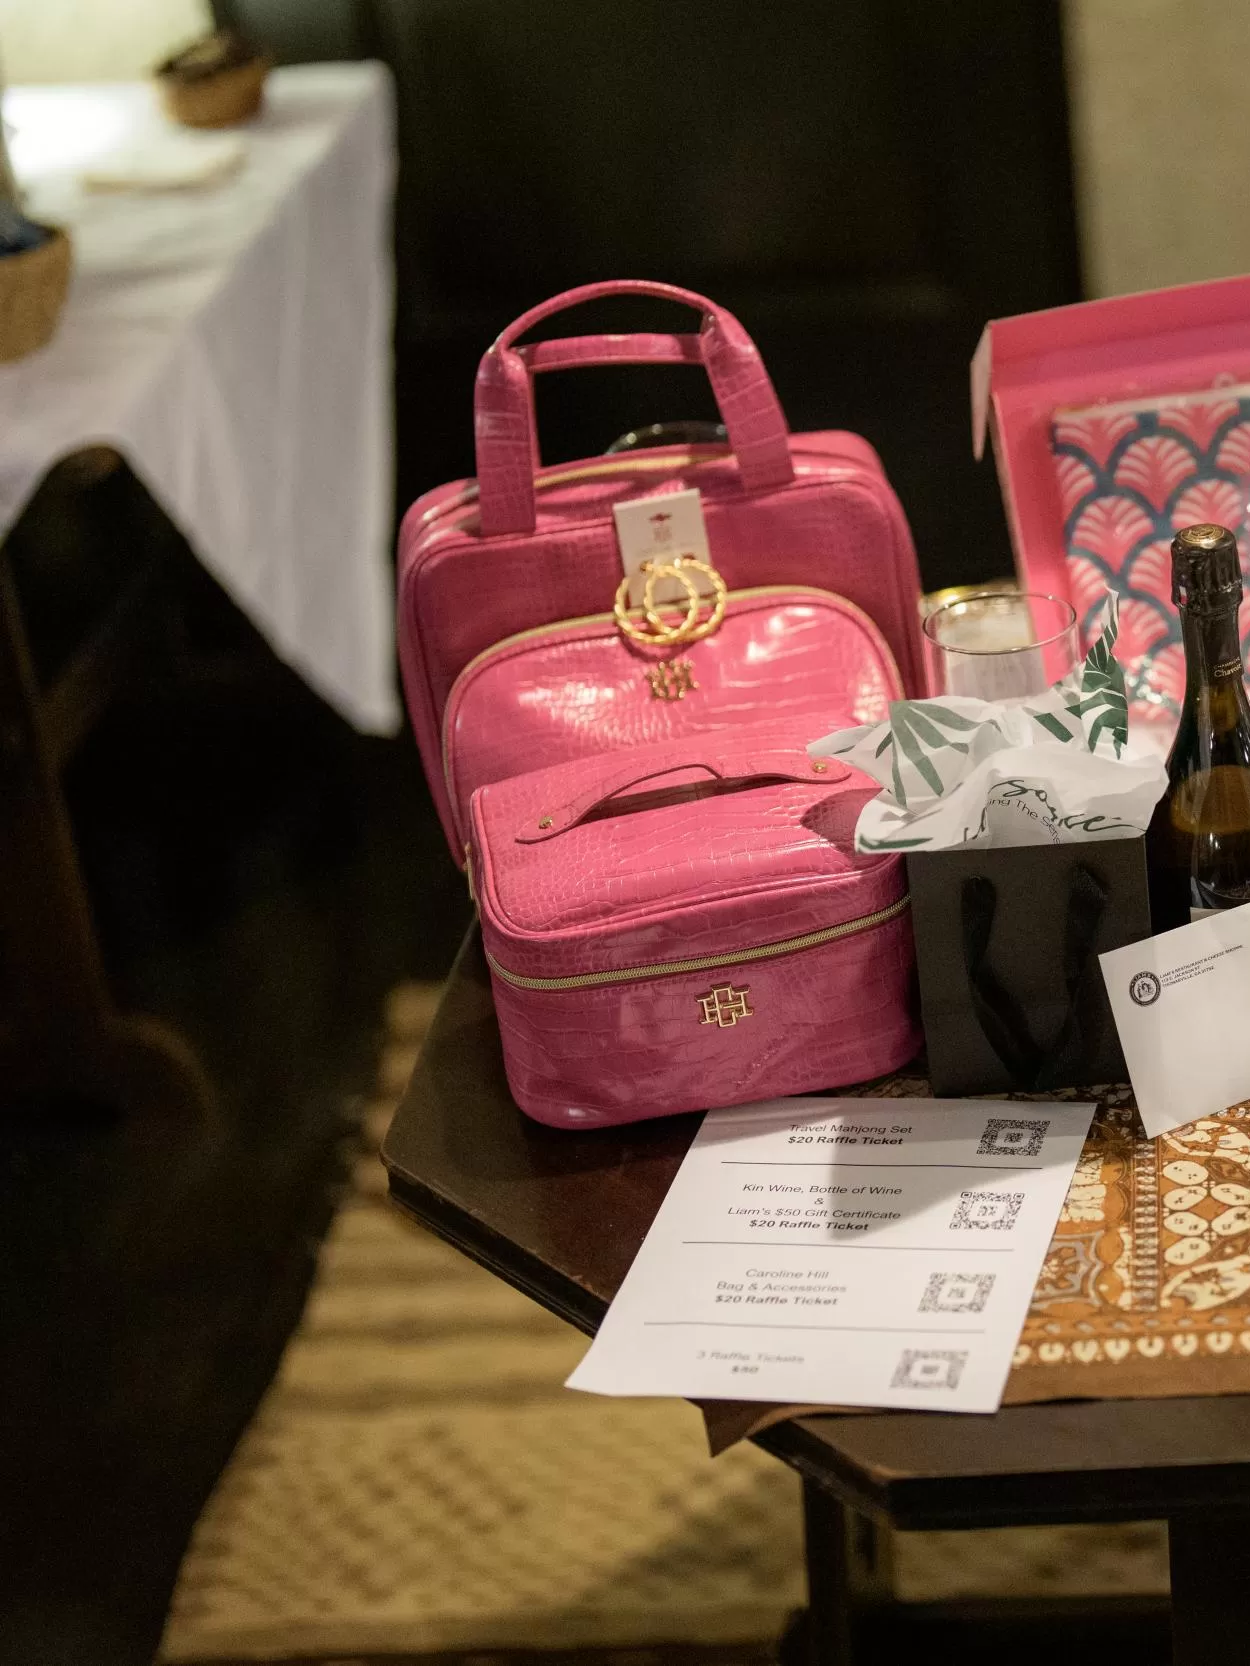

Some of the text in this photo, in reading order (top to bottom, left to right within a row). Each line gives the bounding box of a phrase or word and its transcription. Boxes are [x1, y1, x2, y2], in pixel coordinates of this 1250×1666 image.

[1016, 799, 1039, 820] The
[789, 1124, 913, 1135] Travel Mahjong Set
[788, 1135, 903, 1145] $20 Raffle Ticket
[742, 1184, 903, 1195] Kin Wine, Bottle of Wine
[814, 1197, 825, 1205] &
[727, 1207, 902, 1220] Liam's $50 Gift Certificate
[749, 1219, 869, 1231] $20 Raffle Ticket
[745, 1268, 829, 1279] Caroline Hill
[716, 1281, 847, 1293] Bag & Accessories
[715, 1294, 838, 1305] $20 Raffle Ticket
